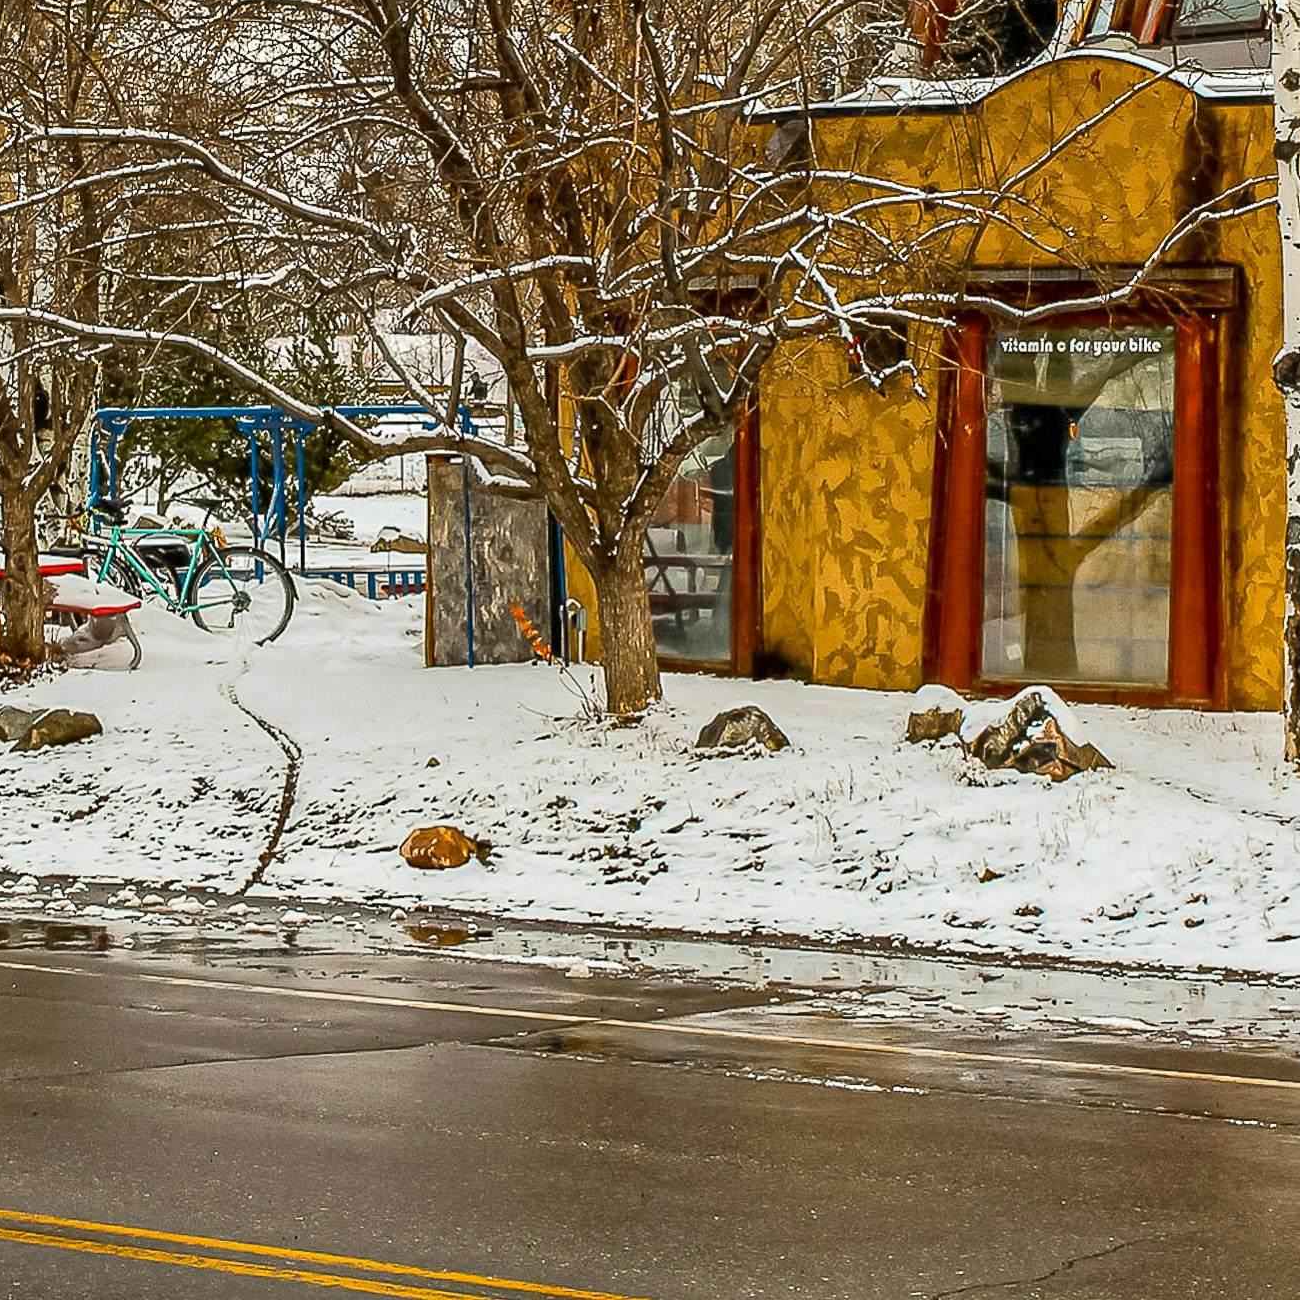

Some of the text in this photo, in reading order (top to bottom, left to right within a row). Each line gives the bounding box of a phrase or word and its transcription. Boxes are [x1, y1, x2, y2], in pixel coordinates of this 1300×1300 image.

[1001, 337, 1053, 353] vitamin
[1069, 337, 1091, 353] for
[1093, 341, 1127, 356] your
[1129, 337, 1162, 353] bike
